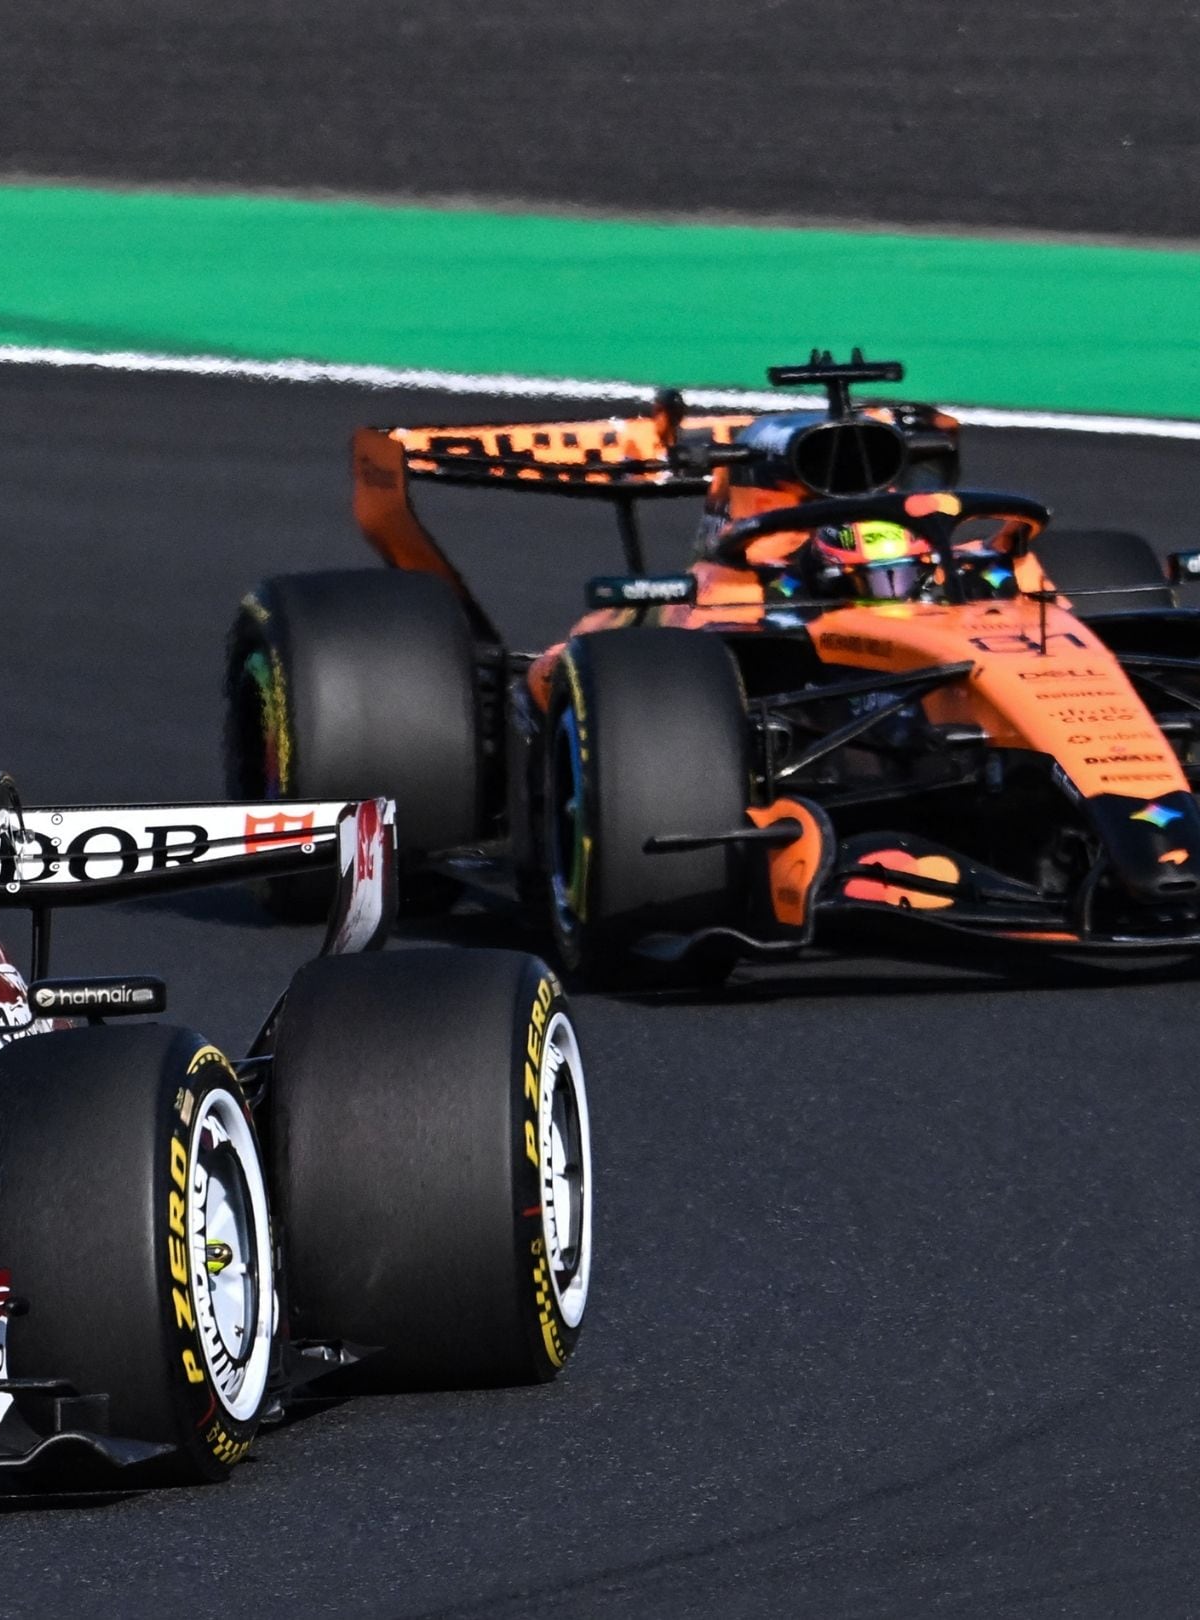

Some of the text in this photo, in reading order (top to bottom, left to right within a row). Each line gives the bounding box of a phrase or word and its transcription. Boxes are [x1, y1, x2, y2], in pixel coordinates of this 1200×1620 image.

[1019, 669, 1106, 680] DELL
[1062, 714, 1134, 724] CISCO
[59, 985, 133, 1006] hahnair
[525, 978, 552, 1167] P ZERO
[168, 1136, 204, 1384] P ZERO
